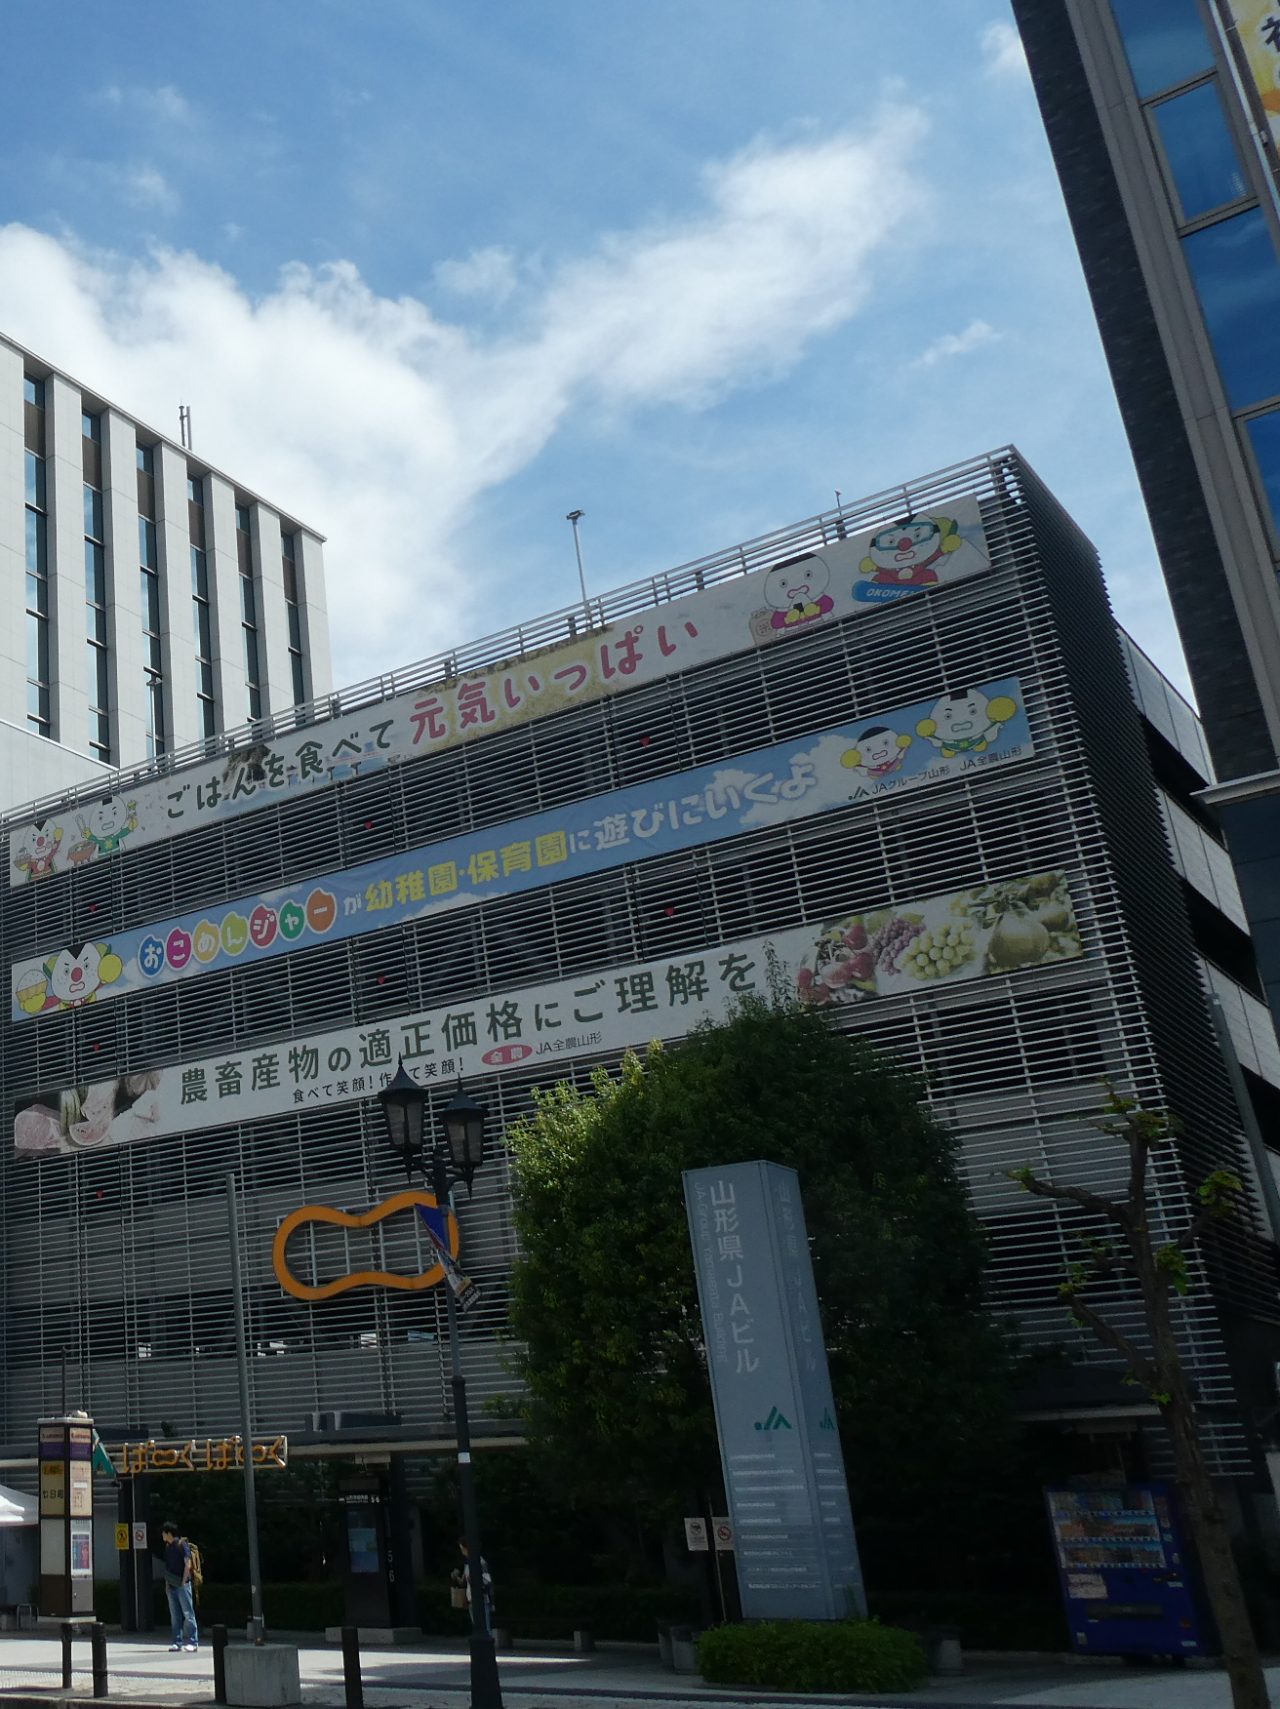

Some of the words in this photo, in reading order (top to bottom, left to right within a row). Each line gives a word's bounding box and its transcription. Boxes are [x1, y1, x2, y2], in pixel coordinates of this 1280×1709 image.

[181, 952, 756, 1105] 農畜産物の適正価格にご理解を
[536, 1031, 602, 1055] JA全農山形
[293, 1057, 464, 1104] 食べて笑顔！作て笑顔！
[710, 1180, 760, 1374] 山形県JAビル
